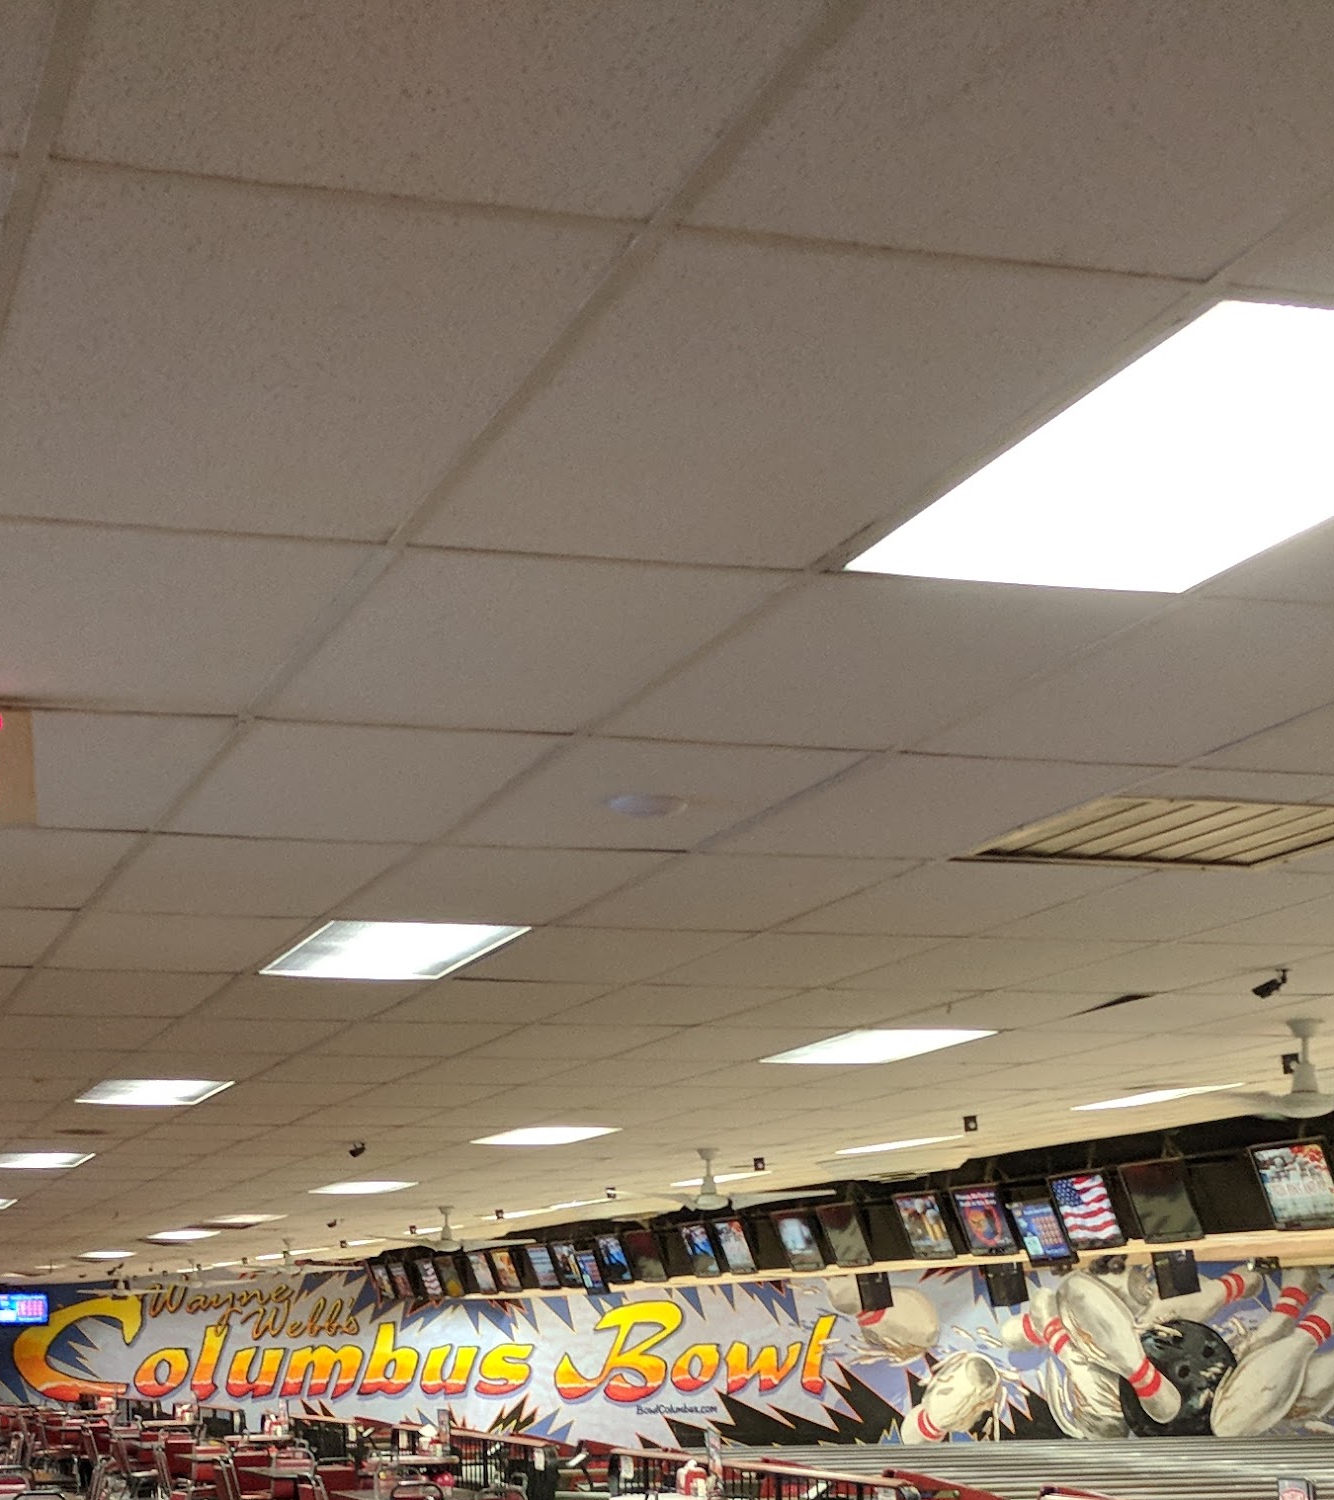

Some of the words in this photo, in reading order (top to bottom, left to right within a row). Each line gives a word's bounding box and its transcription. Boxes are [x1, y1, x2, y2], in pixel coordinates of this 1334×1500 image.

[145, 1278, 296, 1323] Wayne
[241, 1297, 361, 1341] Webb's
[12, 1288, 533, 1402] Columbus
[554, 1299, 839, 1403] Bowl
